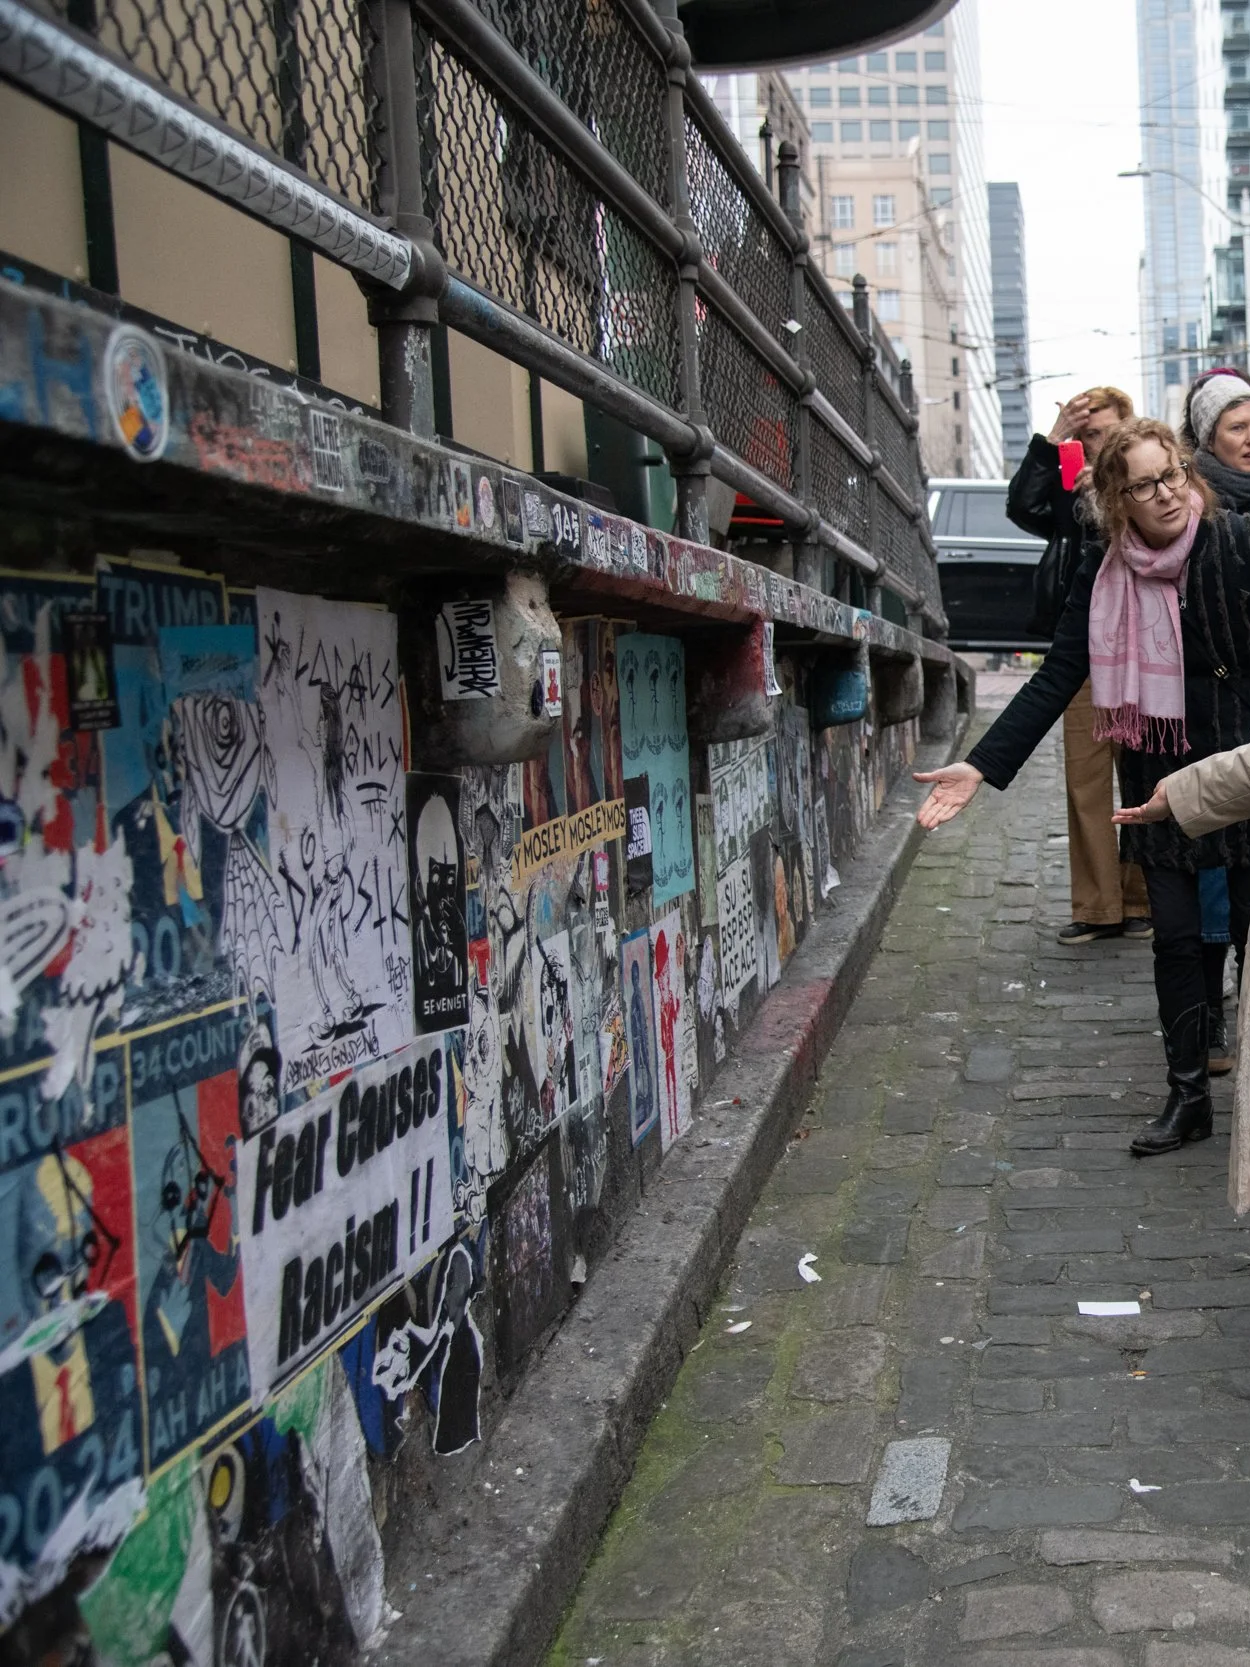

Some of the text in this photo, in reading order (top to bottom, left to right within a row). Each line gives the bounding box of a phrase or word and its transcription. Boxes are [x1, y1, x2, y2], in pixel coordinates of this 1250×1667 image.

[523, 819, 566, 868] MOSLEY
[569, 805, 607, 849] MOSLEY
[423, 994, 467, 1015] SEVENIST
[132, 1050, 161, 1088] 34
[252, 1109, 332, 1236] Fear
[337, 1048, 442, 1178] Causes
[278, 1198, 399, 1366] Racism
